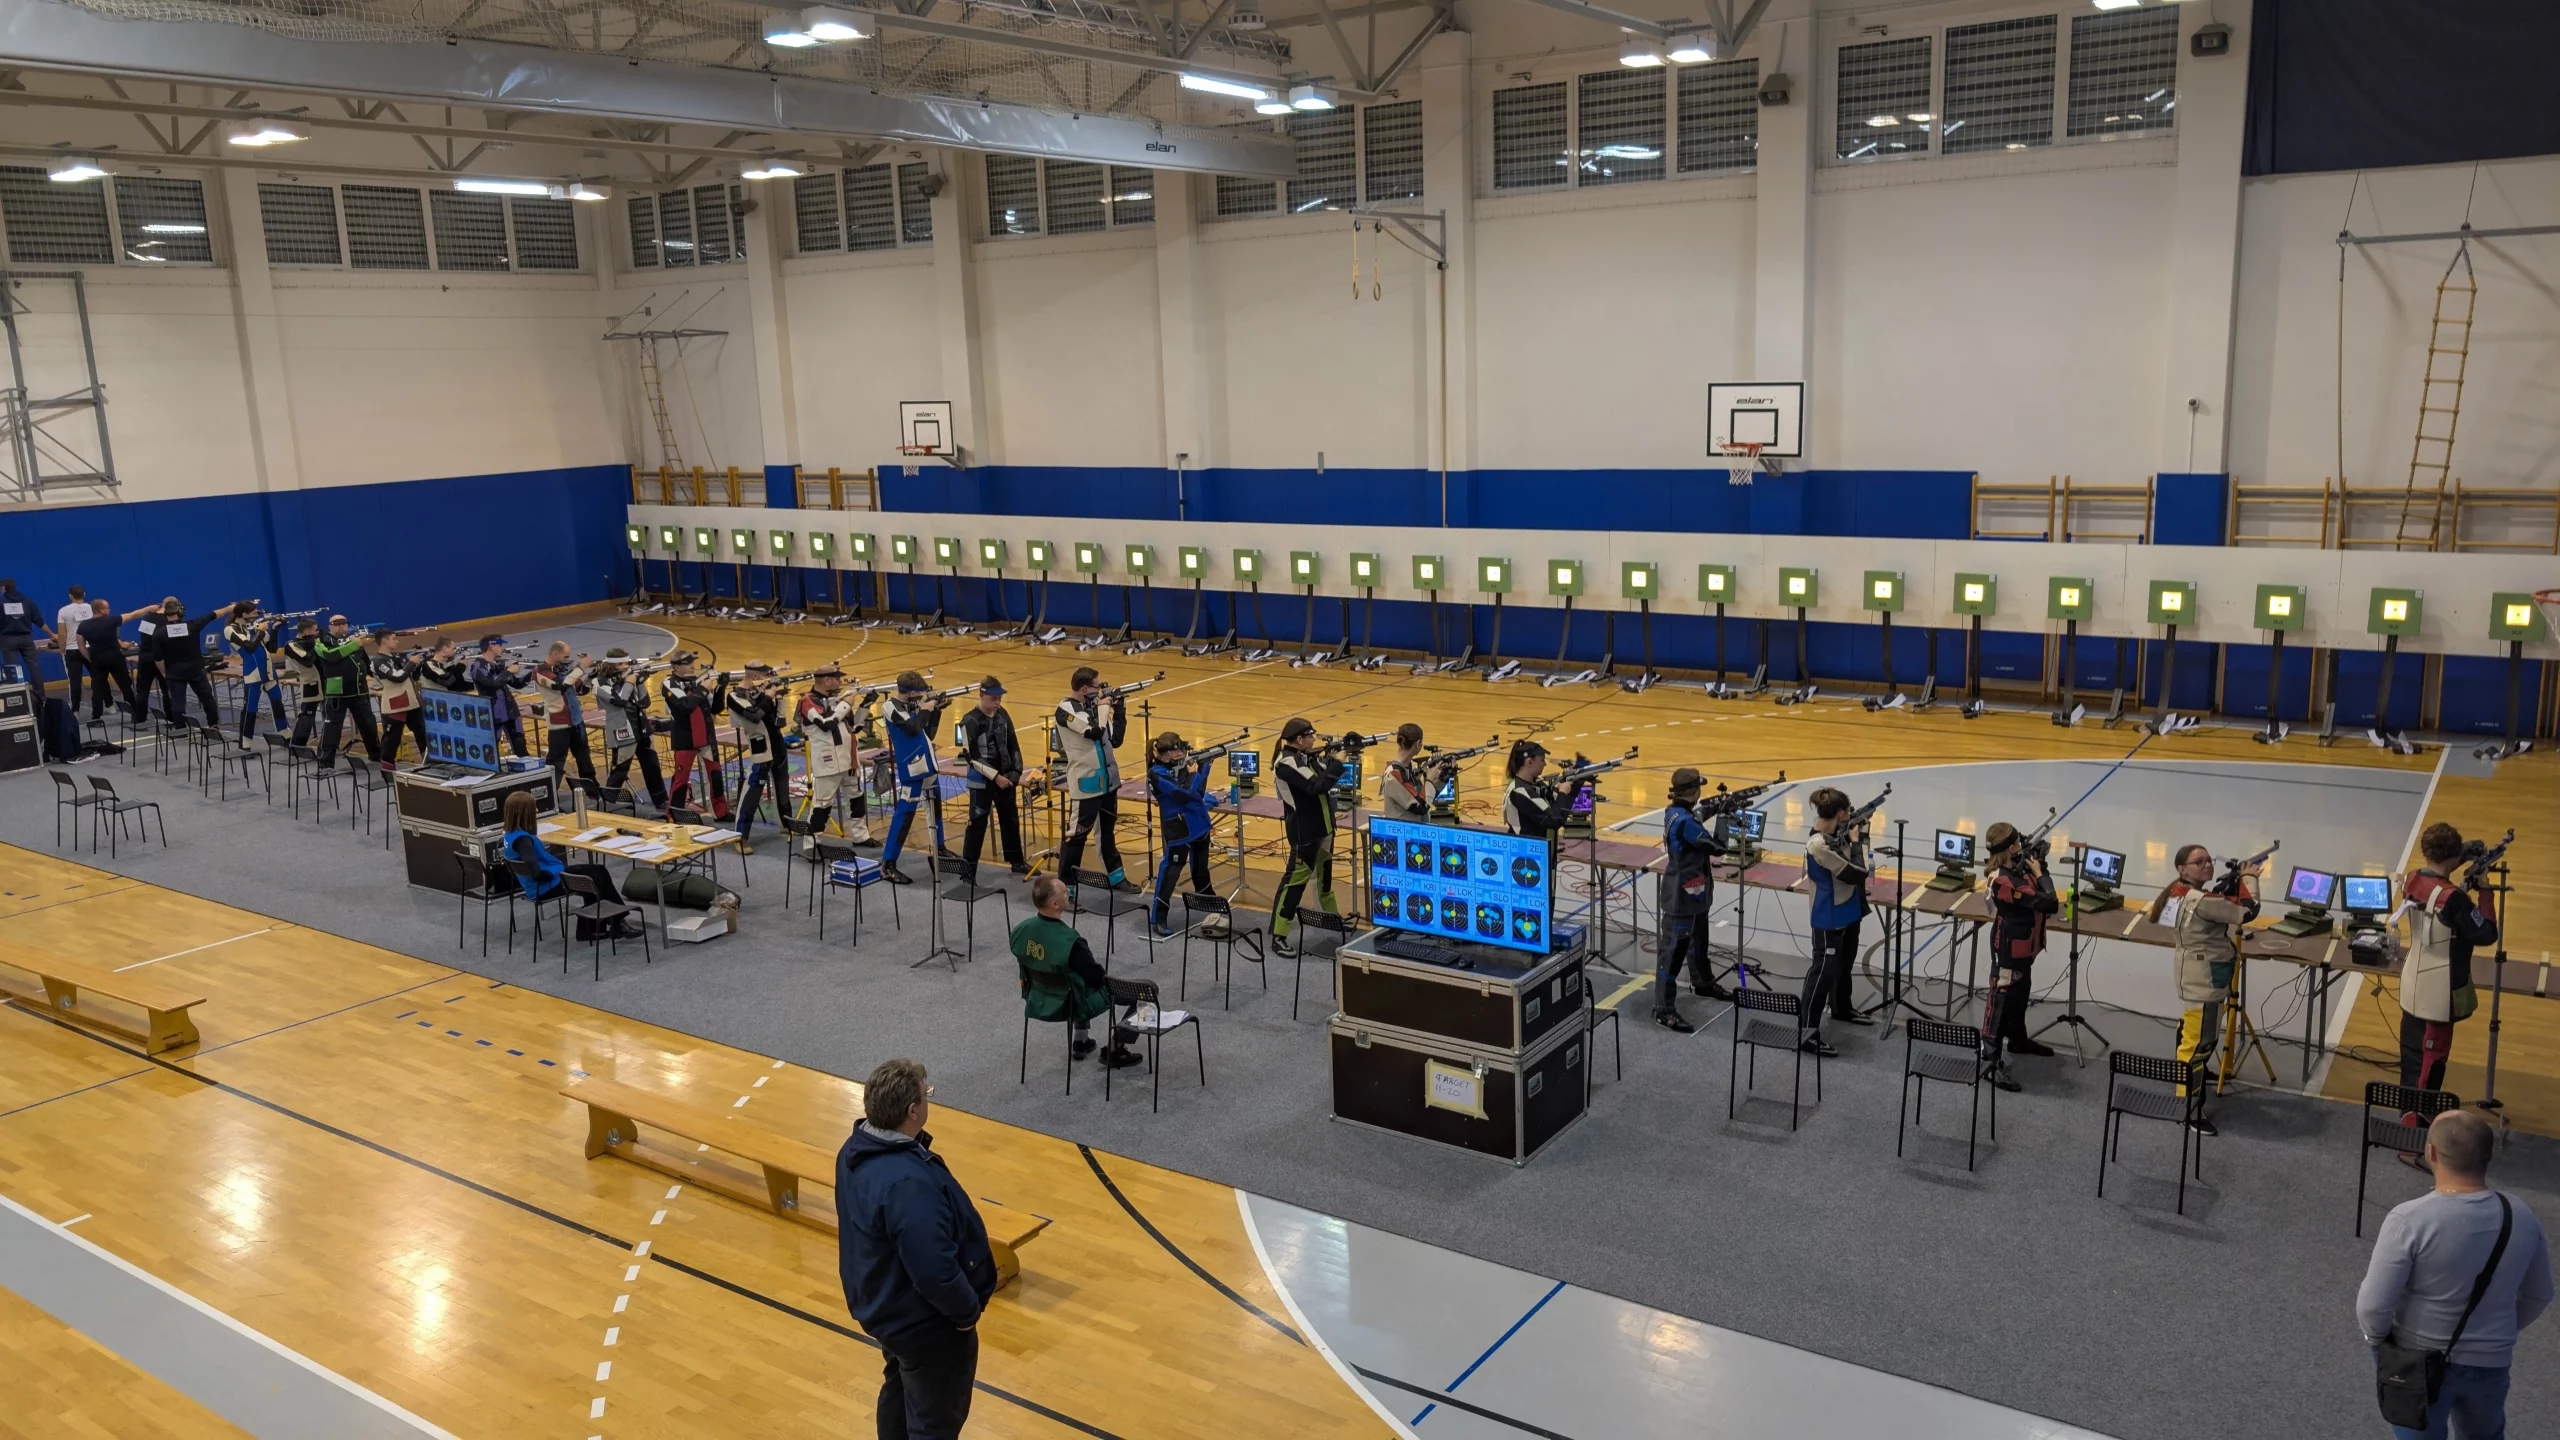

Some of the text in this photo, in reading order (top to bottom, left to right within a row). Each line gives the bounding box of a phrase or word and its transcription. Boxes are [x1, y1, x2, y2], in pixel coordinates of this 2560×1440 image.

[1146, 141, 1176, 153] elan
[1388, 825, 1402, 834] TEK
[1421, 830, 1436, 839] SLO
[1456, 834, 1472, 844] ZEL
[1492, 840, 1508, 848] SLO
[1529, 844, 1544, 854] ZEL
[1389, 878, 1404, 886] LOK
[1424, 883, 1437, 893] KRI
[1457, 888, 1473, 897] LOK
[1493, 893, 1509, 903] SLO
[1530, 900, 1546, 908] LOK
[1026, 940, 1044, 960] RO
[1436, 1074, 1472, 1089] TARGET
